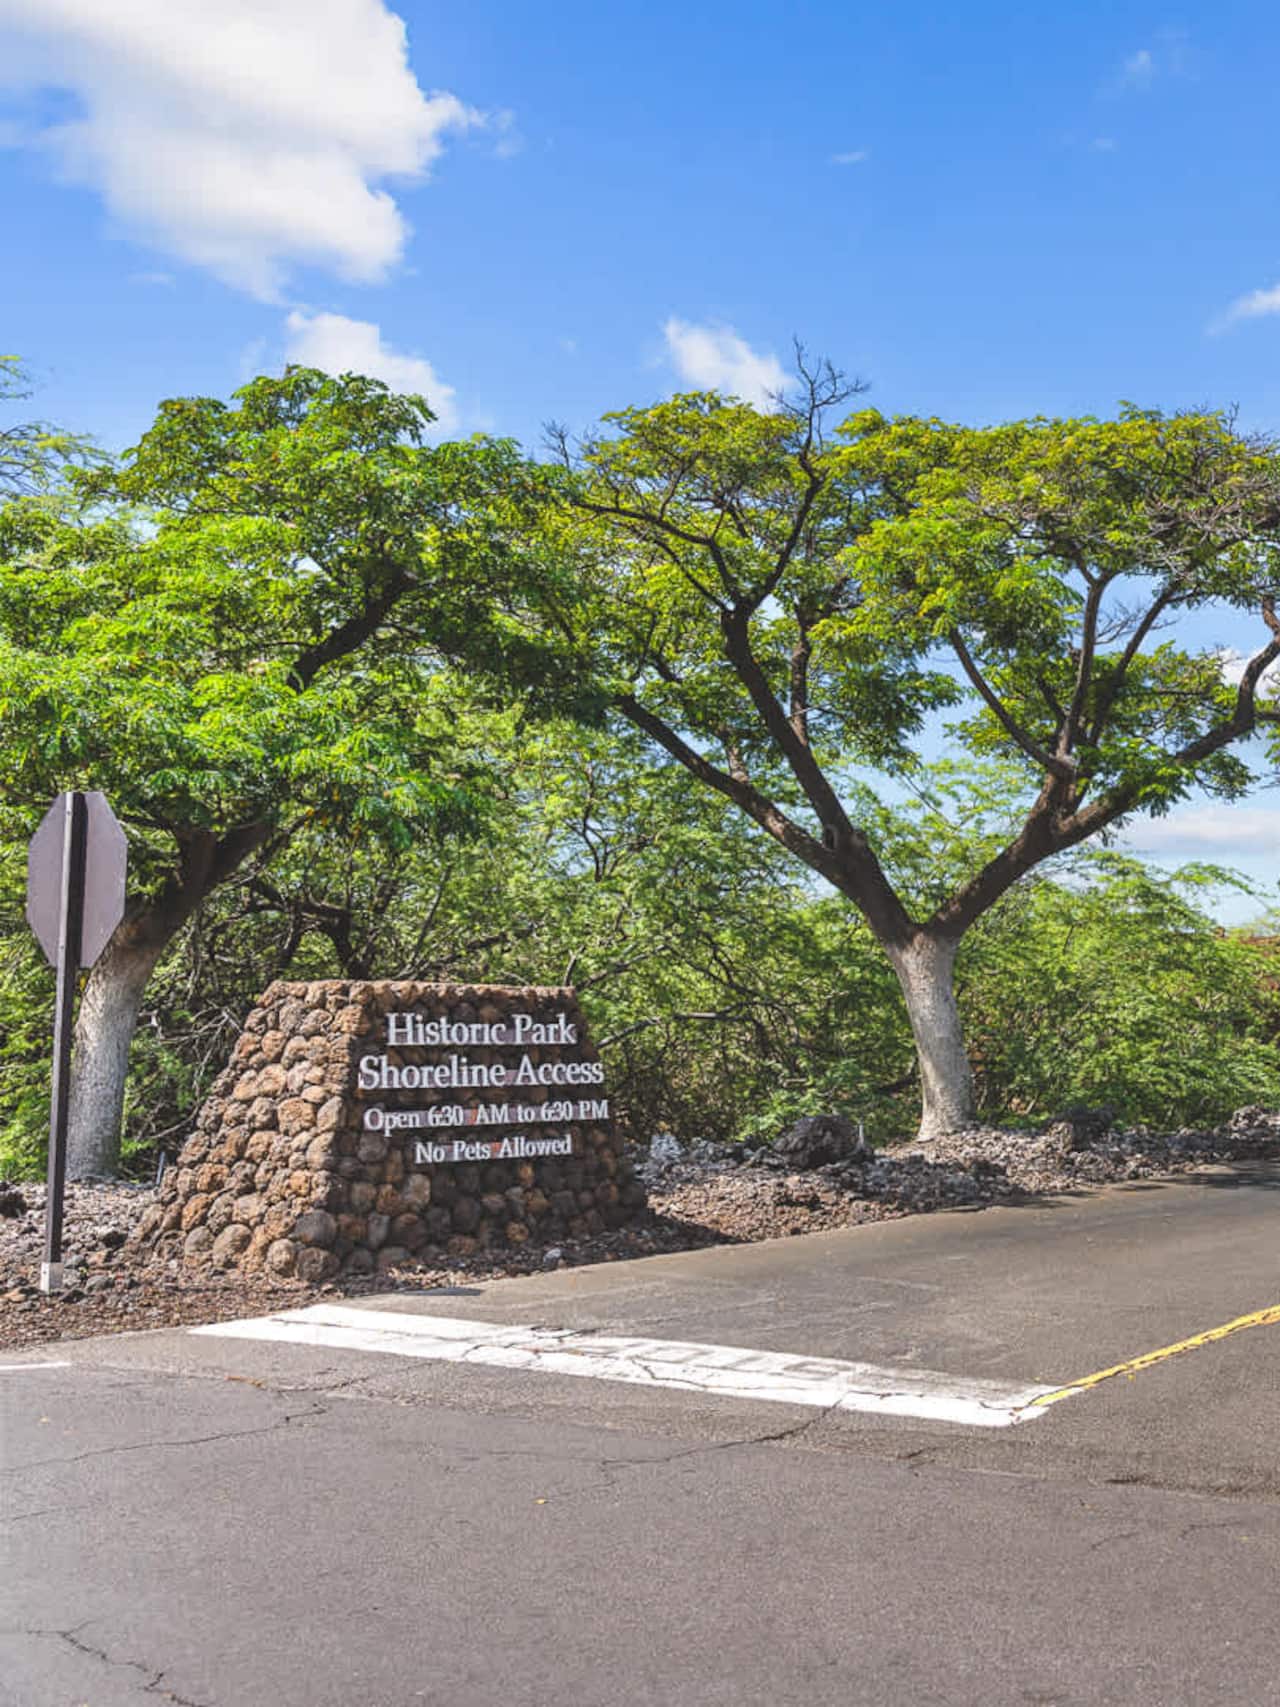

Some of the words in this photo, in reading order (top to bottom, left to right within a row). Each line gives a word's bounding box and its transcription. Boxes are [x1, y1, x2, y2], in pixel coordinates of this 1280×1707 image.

[385, 1012, 507, 1046] Historic
[512, 1013, 577, 1045] Park
[358, 1054, 506, 1090] Shoreline
[515, 1054, 604, 1086] Access
[363, 1107, 420, 1137] Open
[475, 1103, 509, 1124] AM
[517, 1103, 536, 1122] to
[577, 1100, 609, 1120] PM
[414, 1141, 446, 1164] No
[452, 1140, 492, 1162] Pets
[498, 1134, 572, 1159] Allowed
